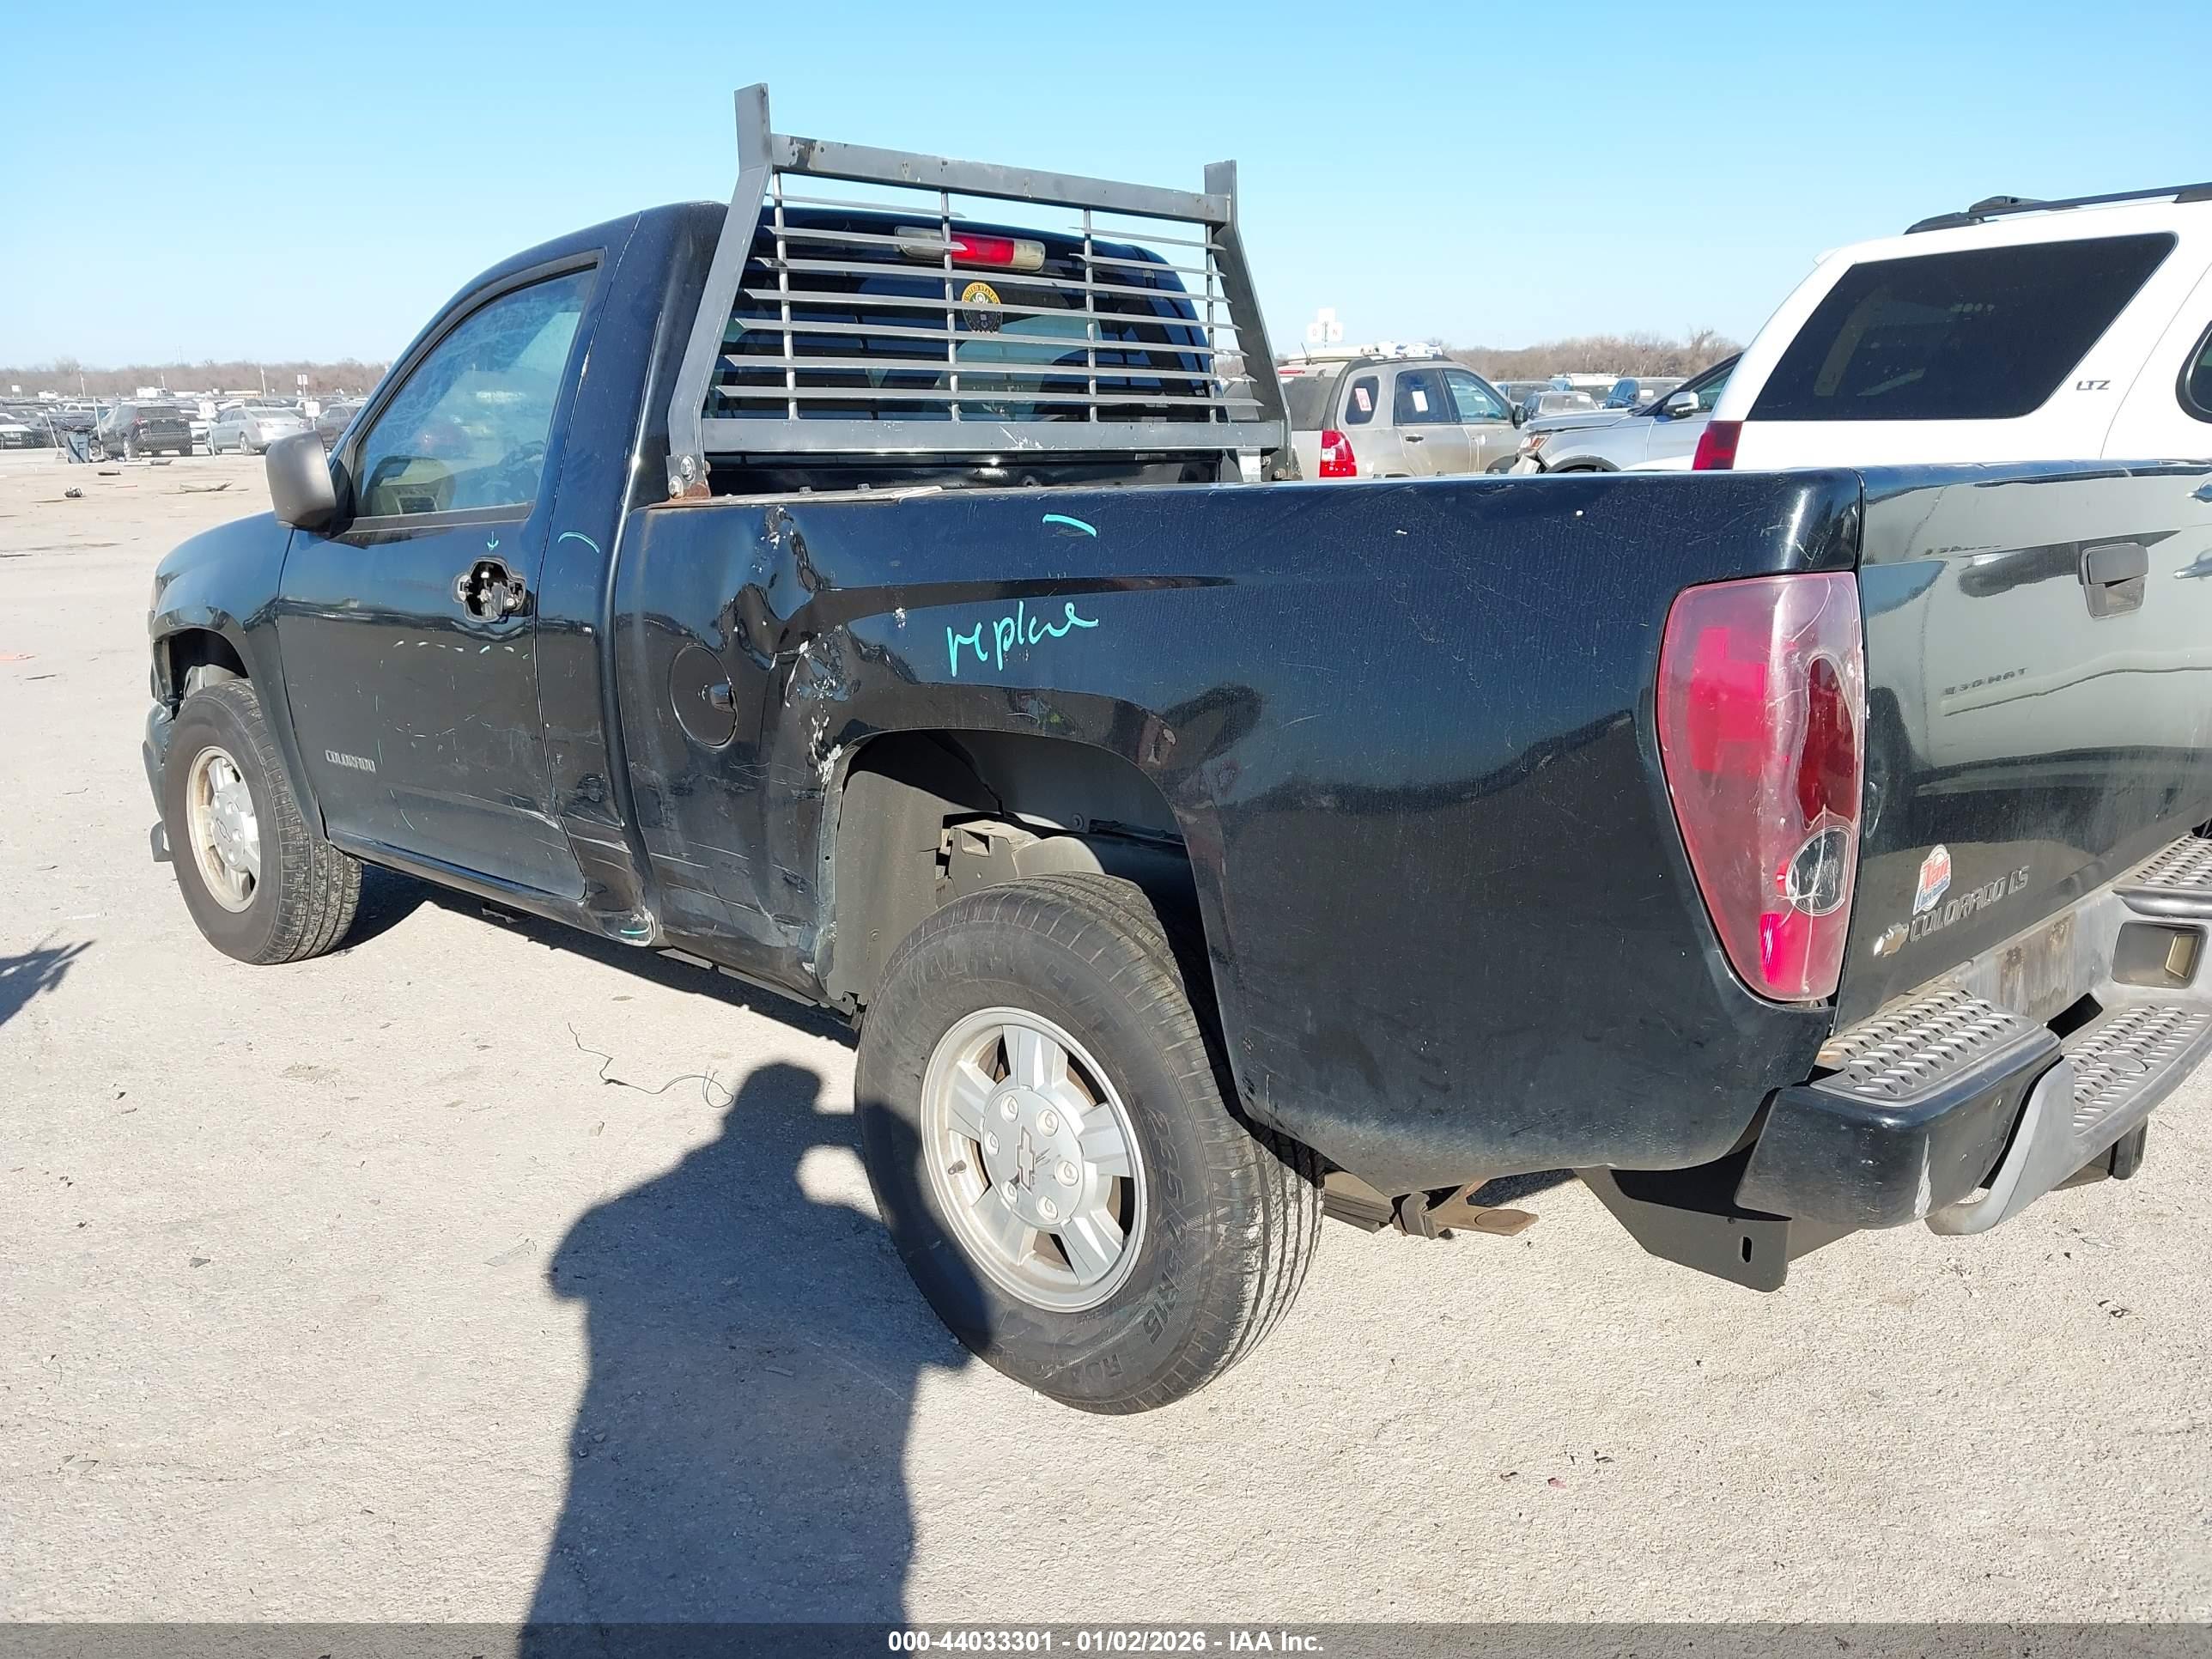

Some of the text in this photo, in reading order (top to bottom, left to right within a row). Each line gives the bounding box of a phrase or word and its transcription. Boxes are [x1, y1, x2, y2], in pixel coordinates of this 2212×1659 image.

[2075, 380, 2111, 391] LTZ
[325, 749, 377, 774] COLORADO
[1909, 876, 2007, 943] COLORADO
[2007, 865, 2030, 896] LS
